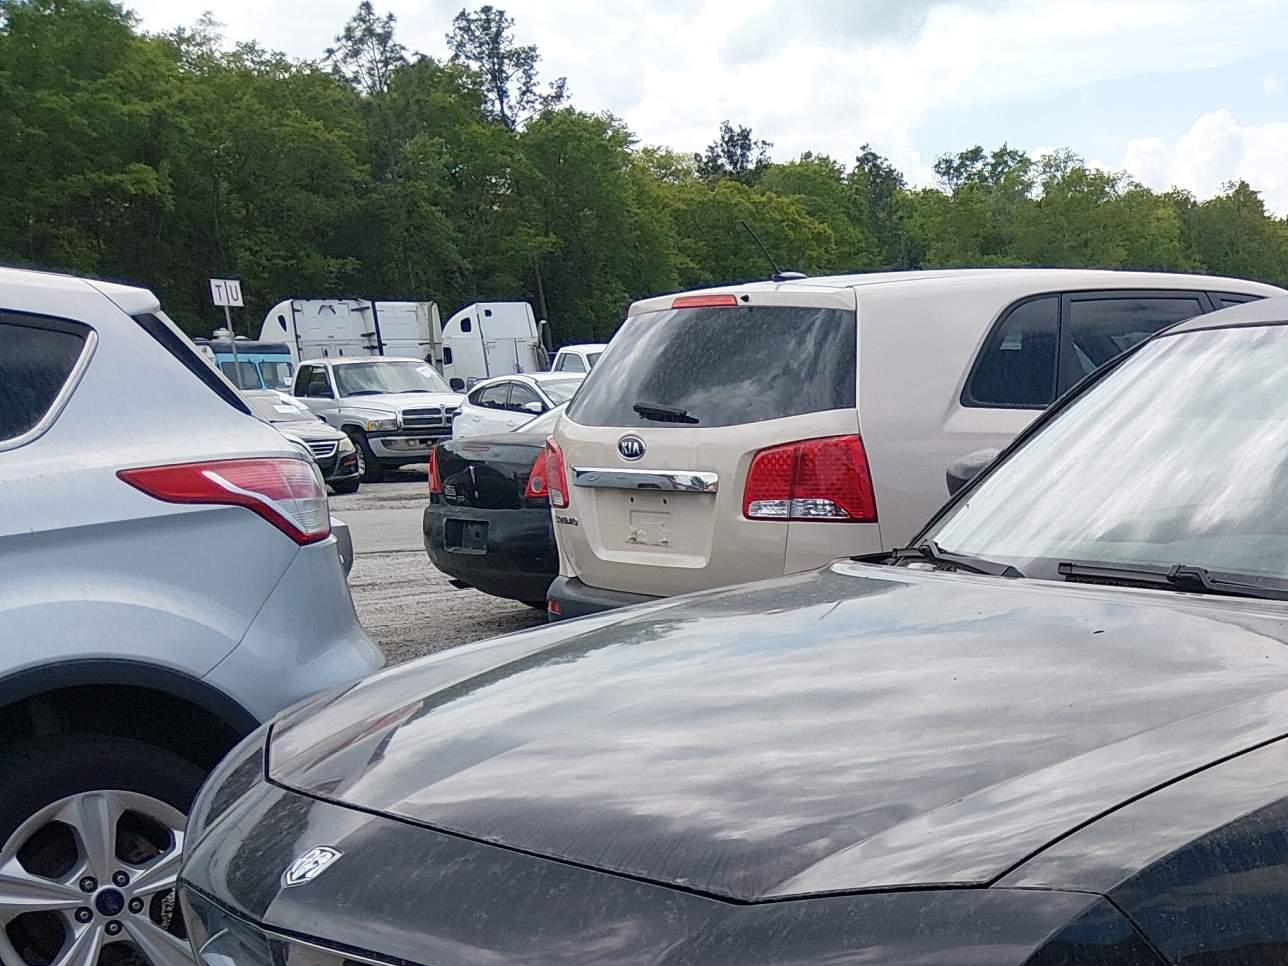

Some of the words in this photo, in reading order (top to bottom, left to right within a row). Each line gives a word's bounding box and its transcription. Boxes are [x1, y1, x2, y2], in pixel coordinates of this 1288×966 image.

[214, 284, 222, 302] T
[229, 285, 239, 302] U
[621, 441, 641, 456] KIA
